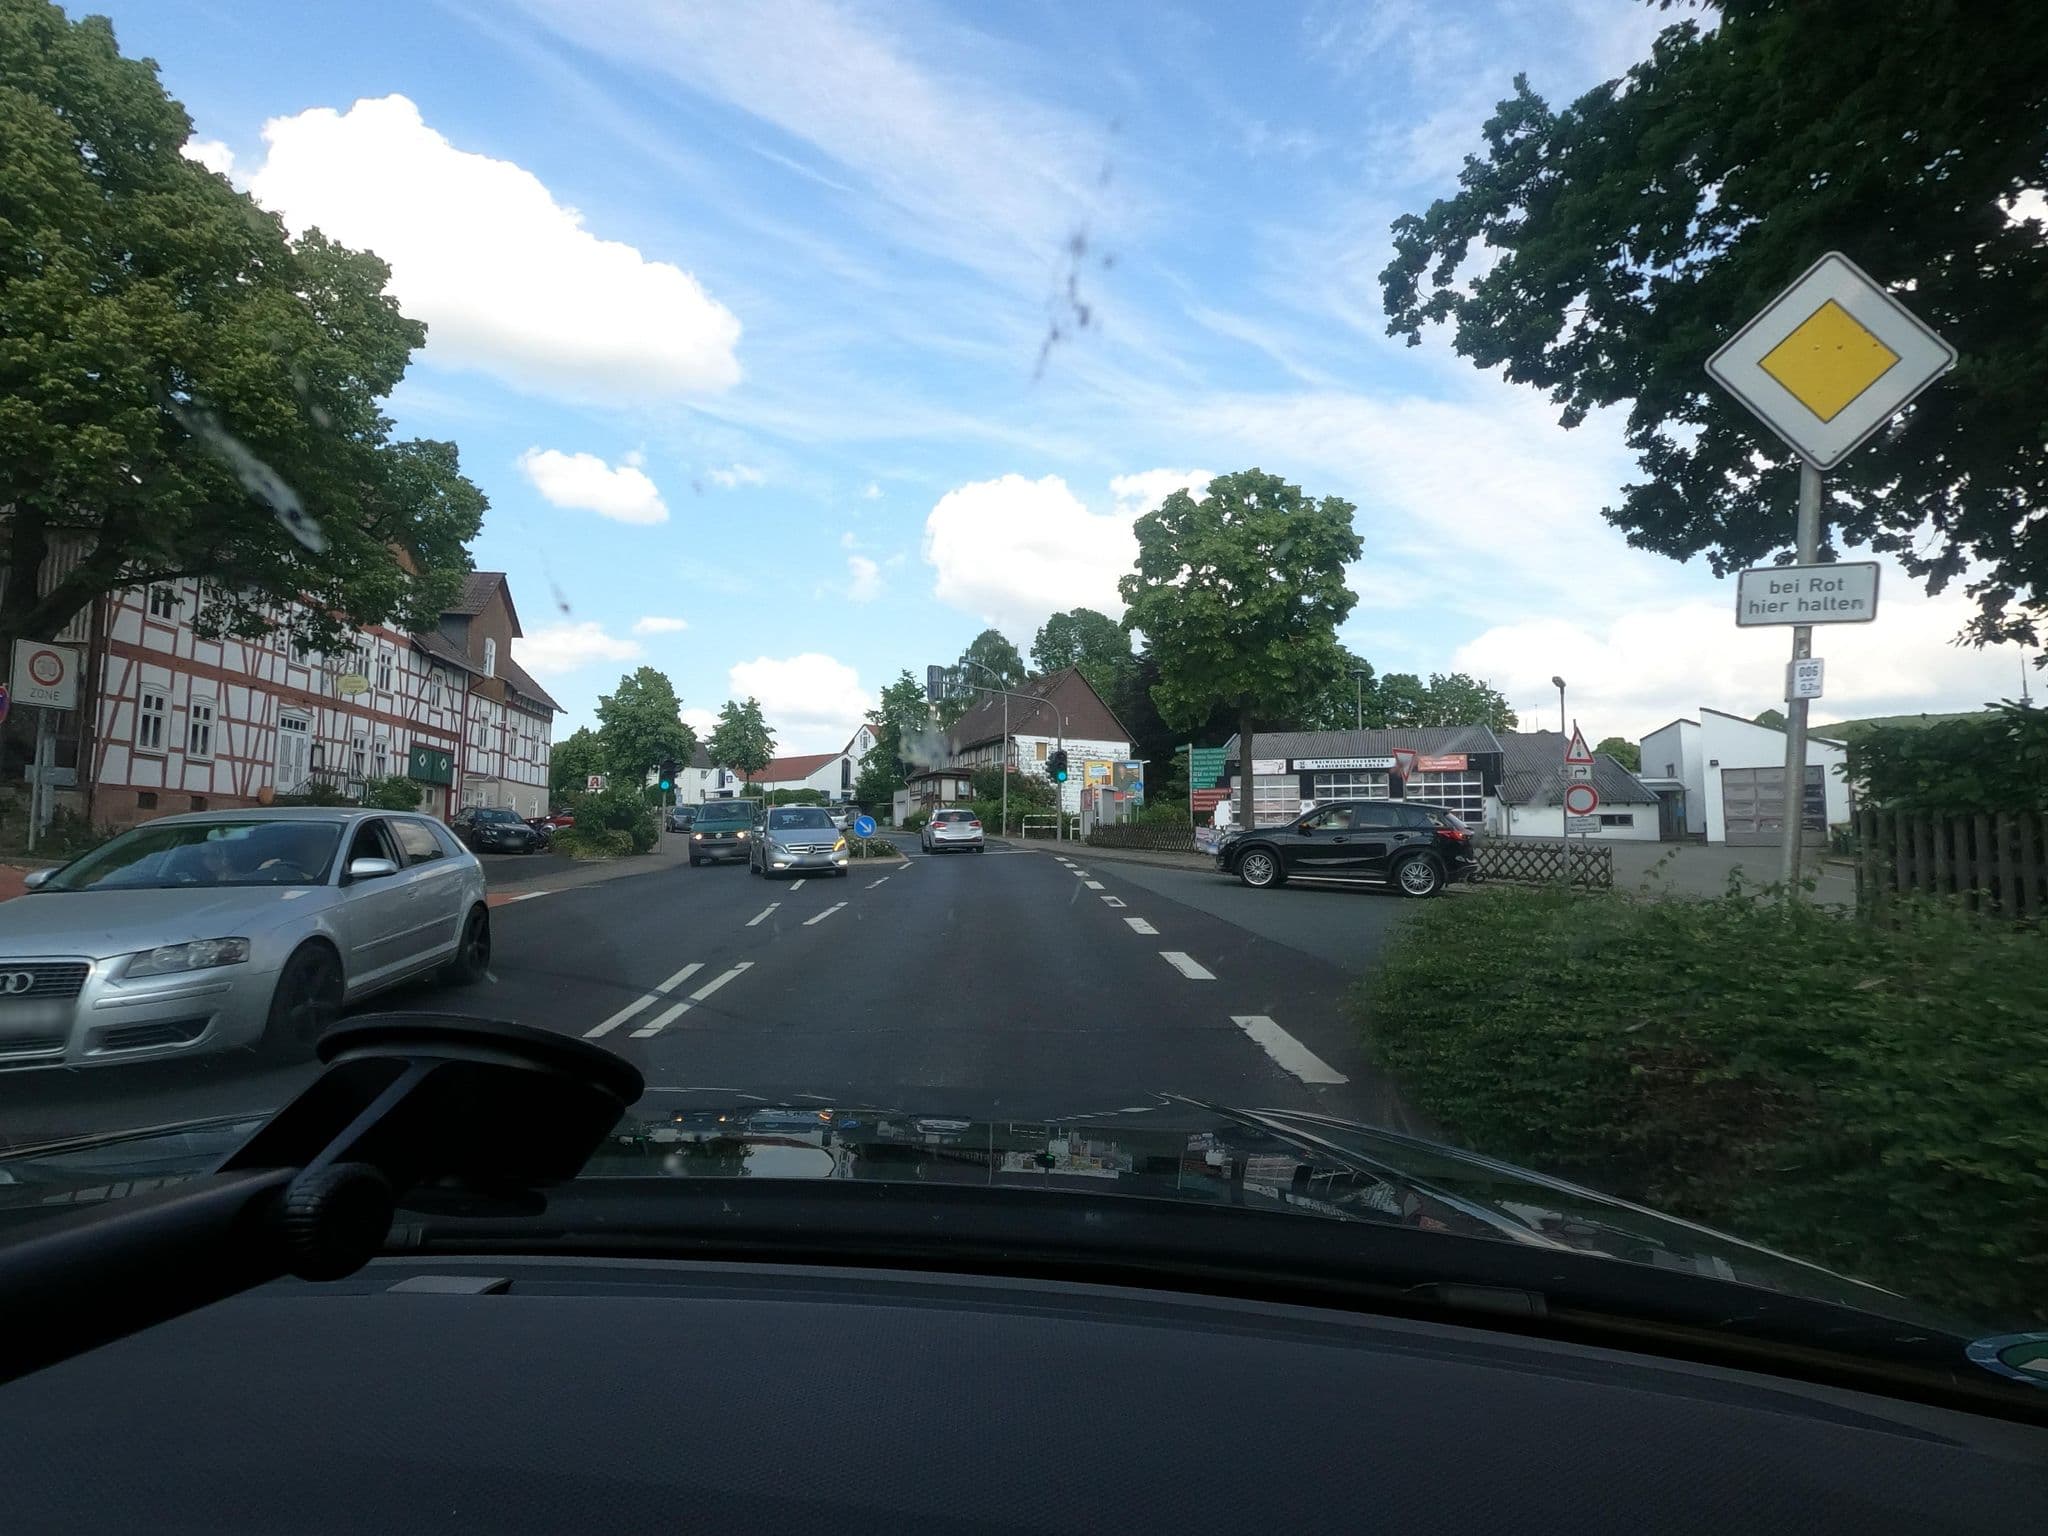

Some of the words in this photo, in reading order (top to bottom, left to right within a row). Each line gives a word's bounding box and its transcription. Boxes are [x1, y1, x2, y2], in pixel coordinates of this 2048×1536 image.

[1769, 579, 1800, 594] bei
[1809, 577, 1845, 592] Rot
[1749, 600, 1790, 614] hier
[1797, 596, 1865, 612] halten
[30, 687, 61, 702] ZONE
